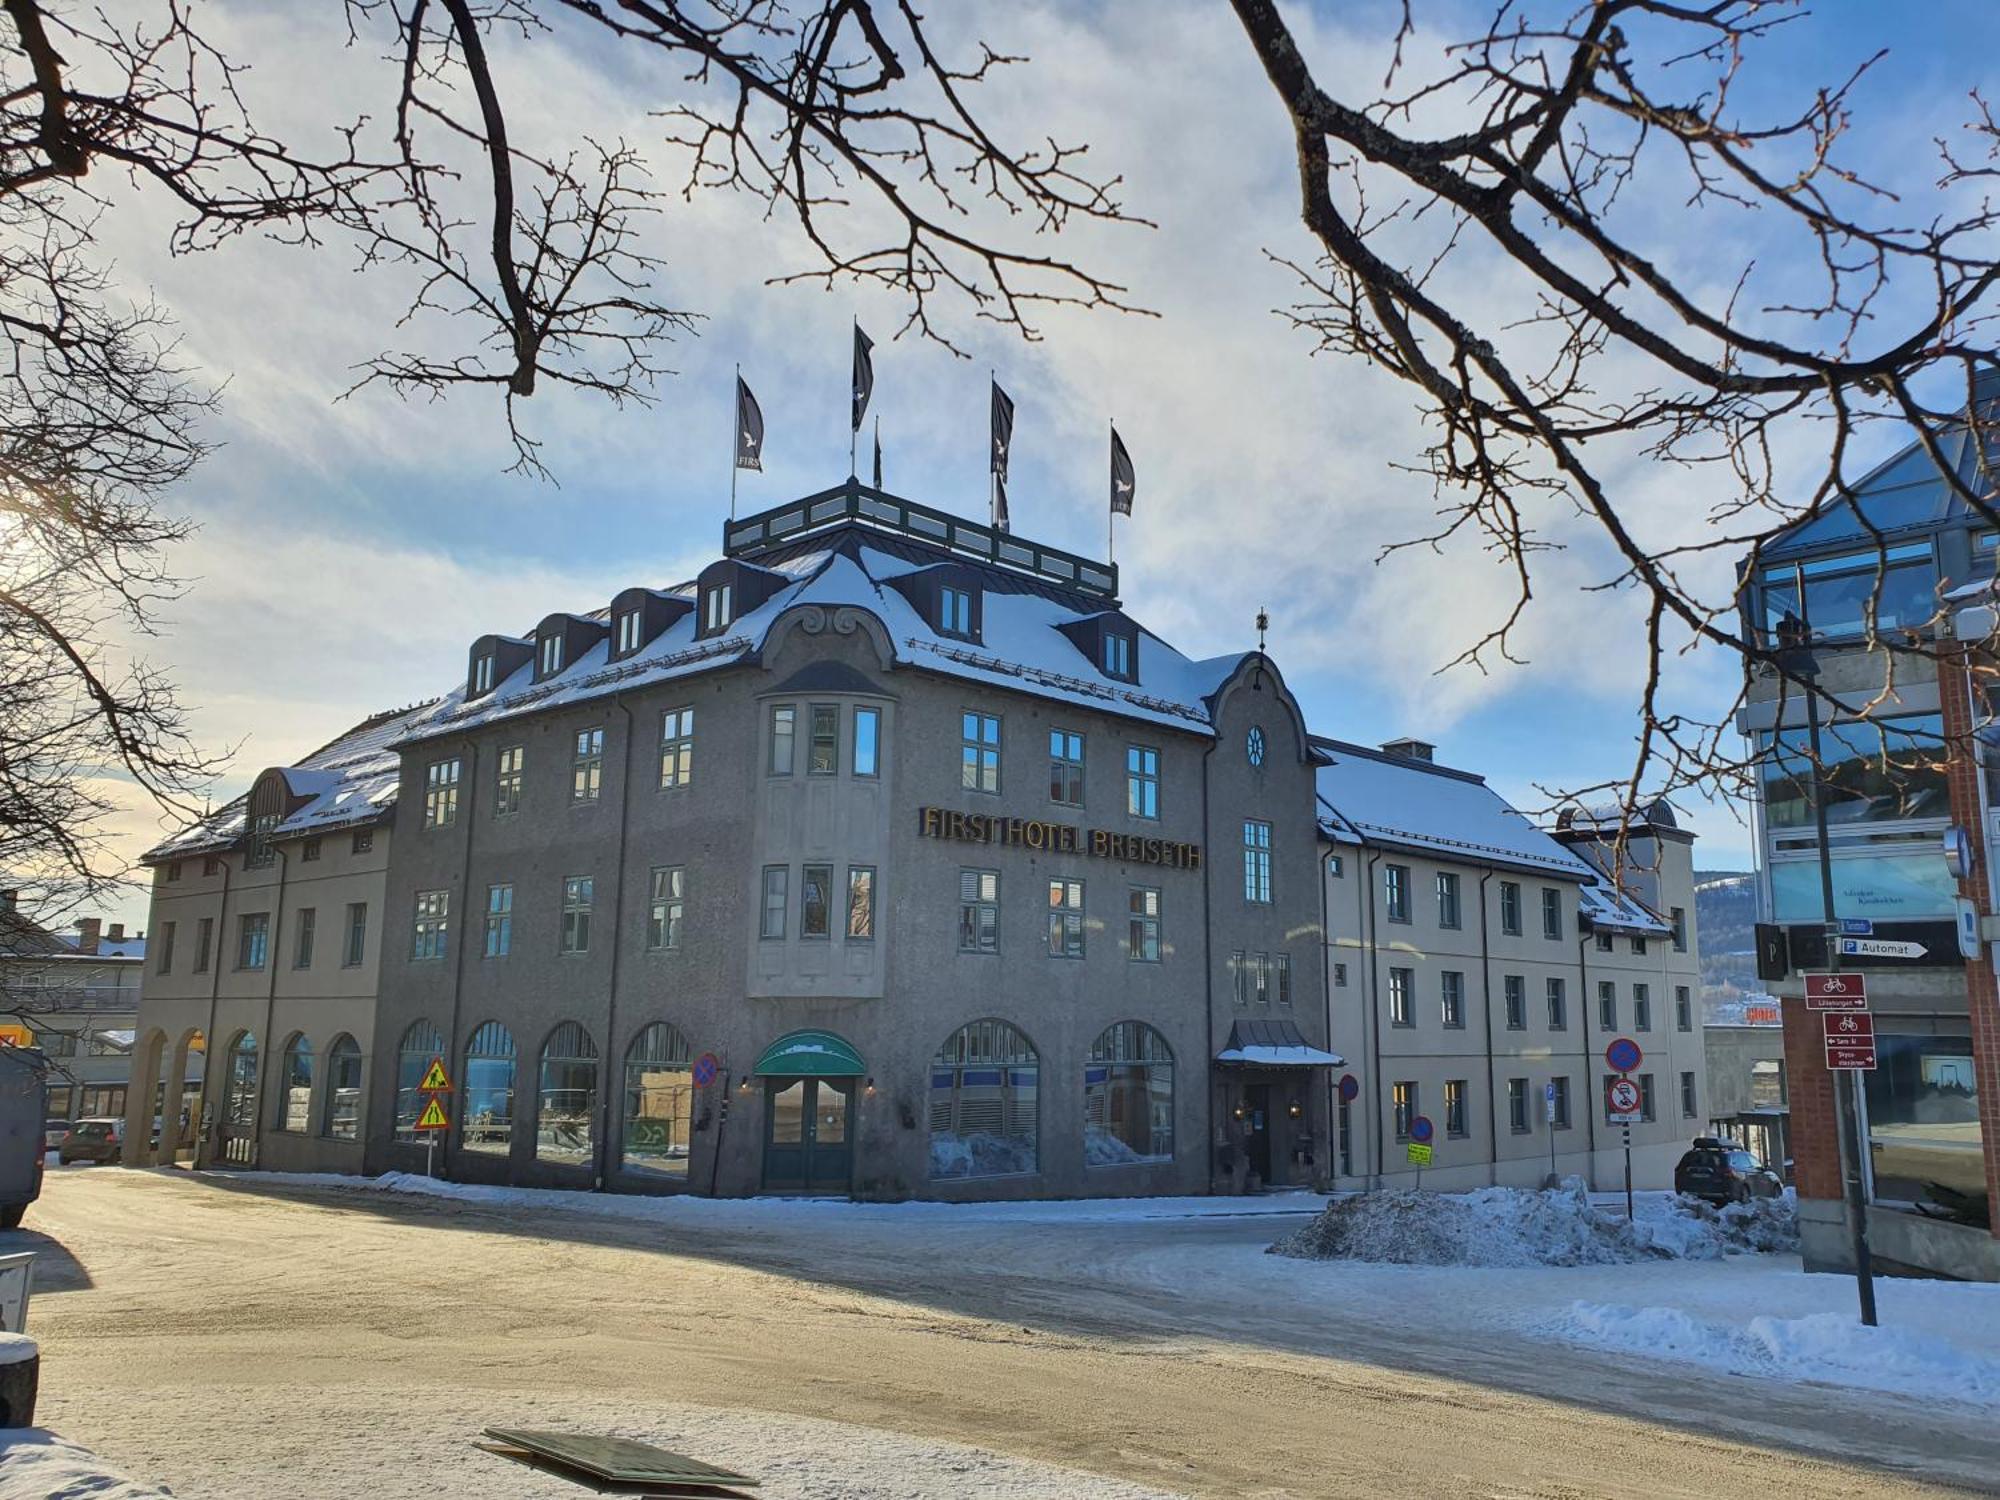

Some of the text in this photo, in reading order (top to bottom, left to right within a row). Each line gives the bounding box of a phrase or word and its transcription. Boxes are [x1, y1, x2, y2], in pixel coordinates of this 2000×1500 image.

[919, 807, 1200, 870] FIRST HOTEL BREISETH
[1861, 943, 1908, 954] Automat
